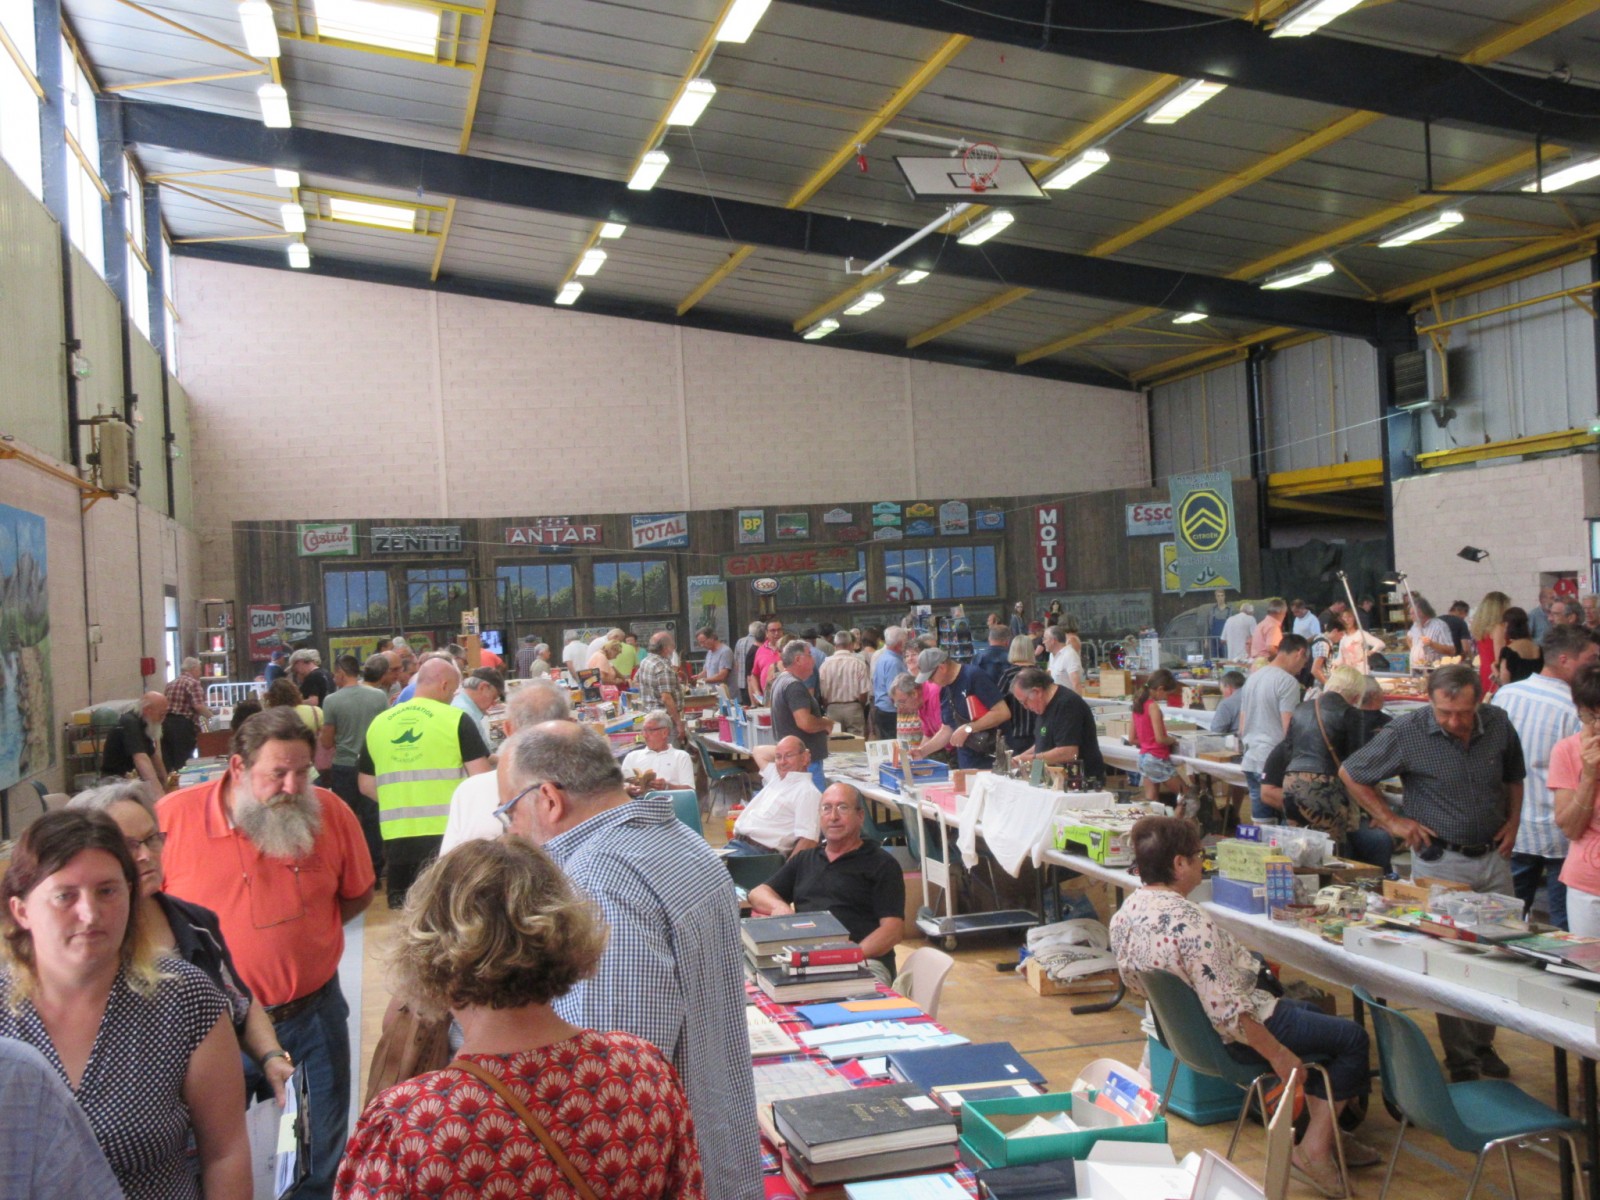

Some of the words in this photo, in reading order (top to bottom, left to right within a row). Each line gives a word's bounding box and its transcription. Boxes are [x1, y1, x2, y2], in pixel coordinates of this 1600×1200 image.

[635, 520, 685, 544] TOTAL
[743, 518, 762, 530] BP
[303, 526, 348, 553] Castrol
[375, 534, 460, 551] ZENITH
[511, 527, 597, 544] ANTAR
[1039, 509, 1057, 588] MOTUL
[727, 551, 818, 575] GARAGE
[251, 612, 310, 628] CHAMPION
[387, 705, 434, 721] ORGANISATION
